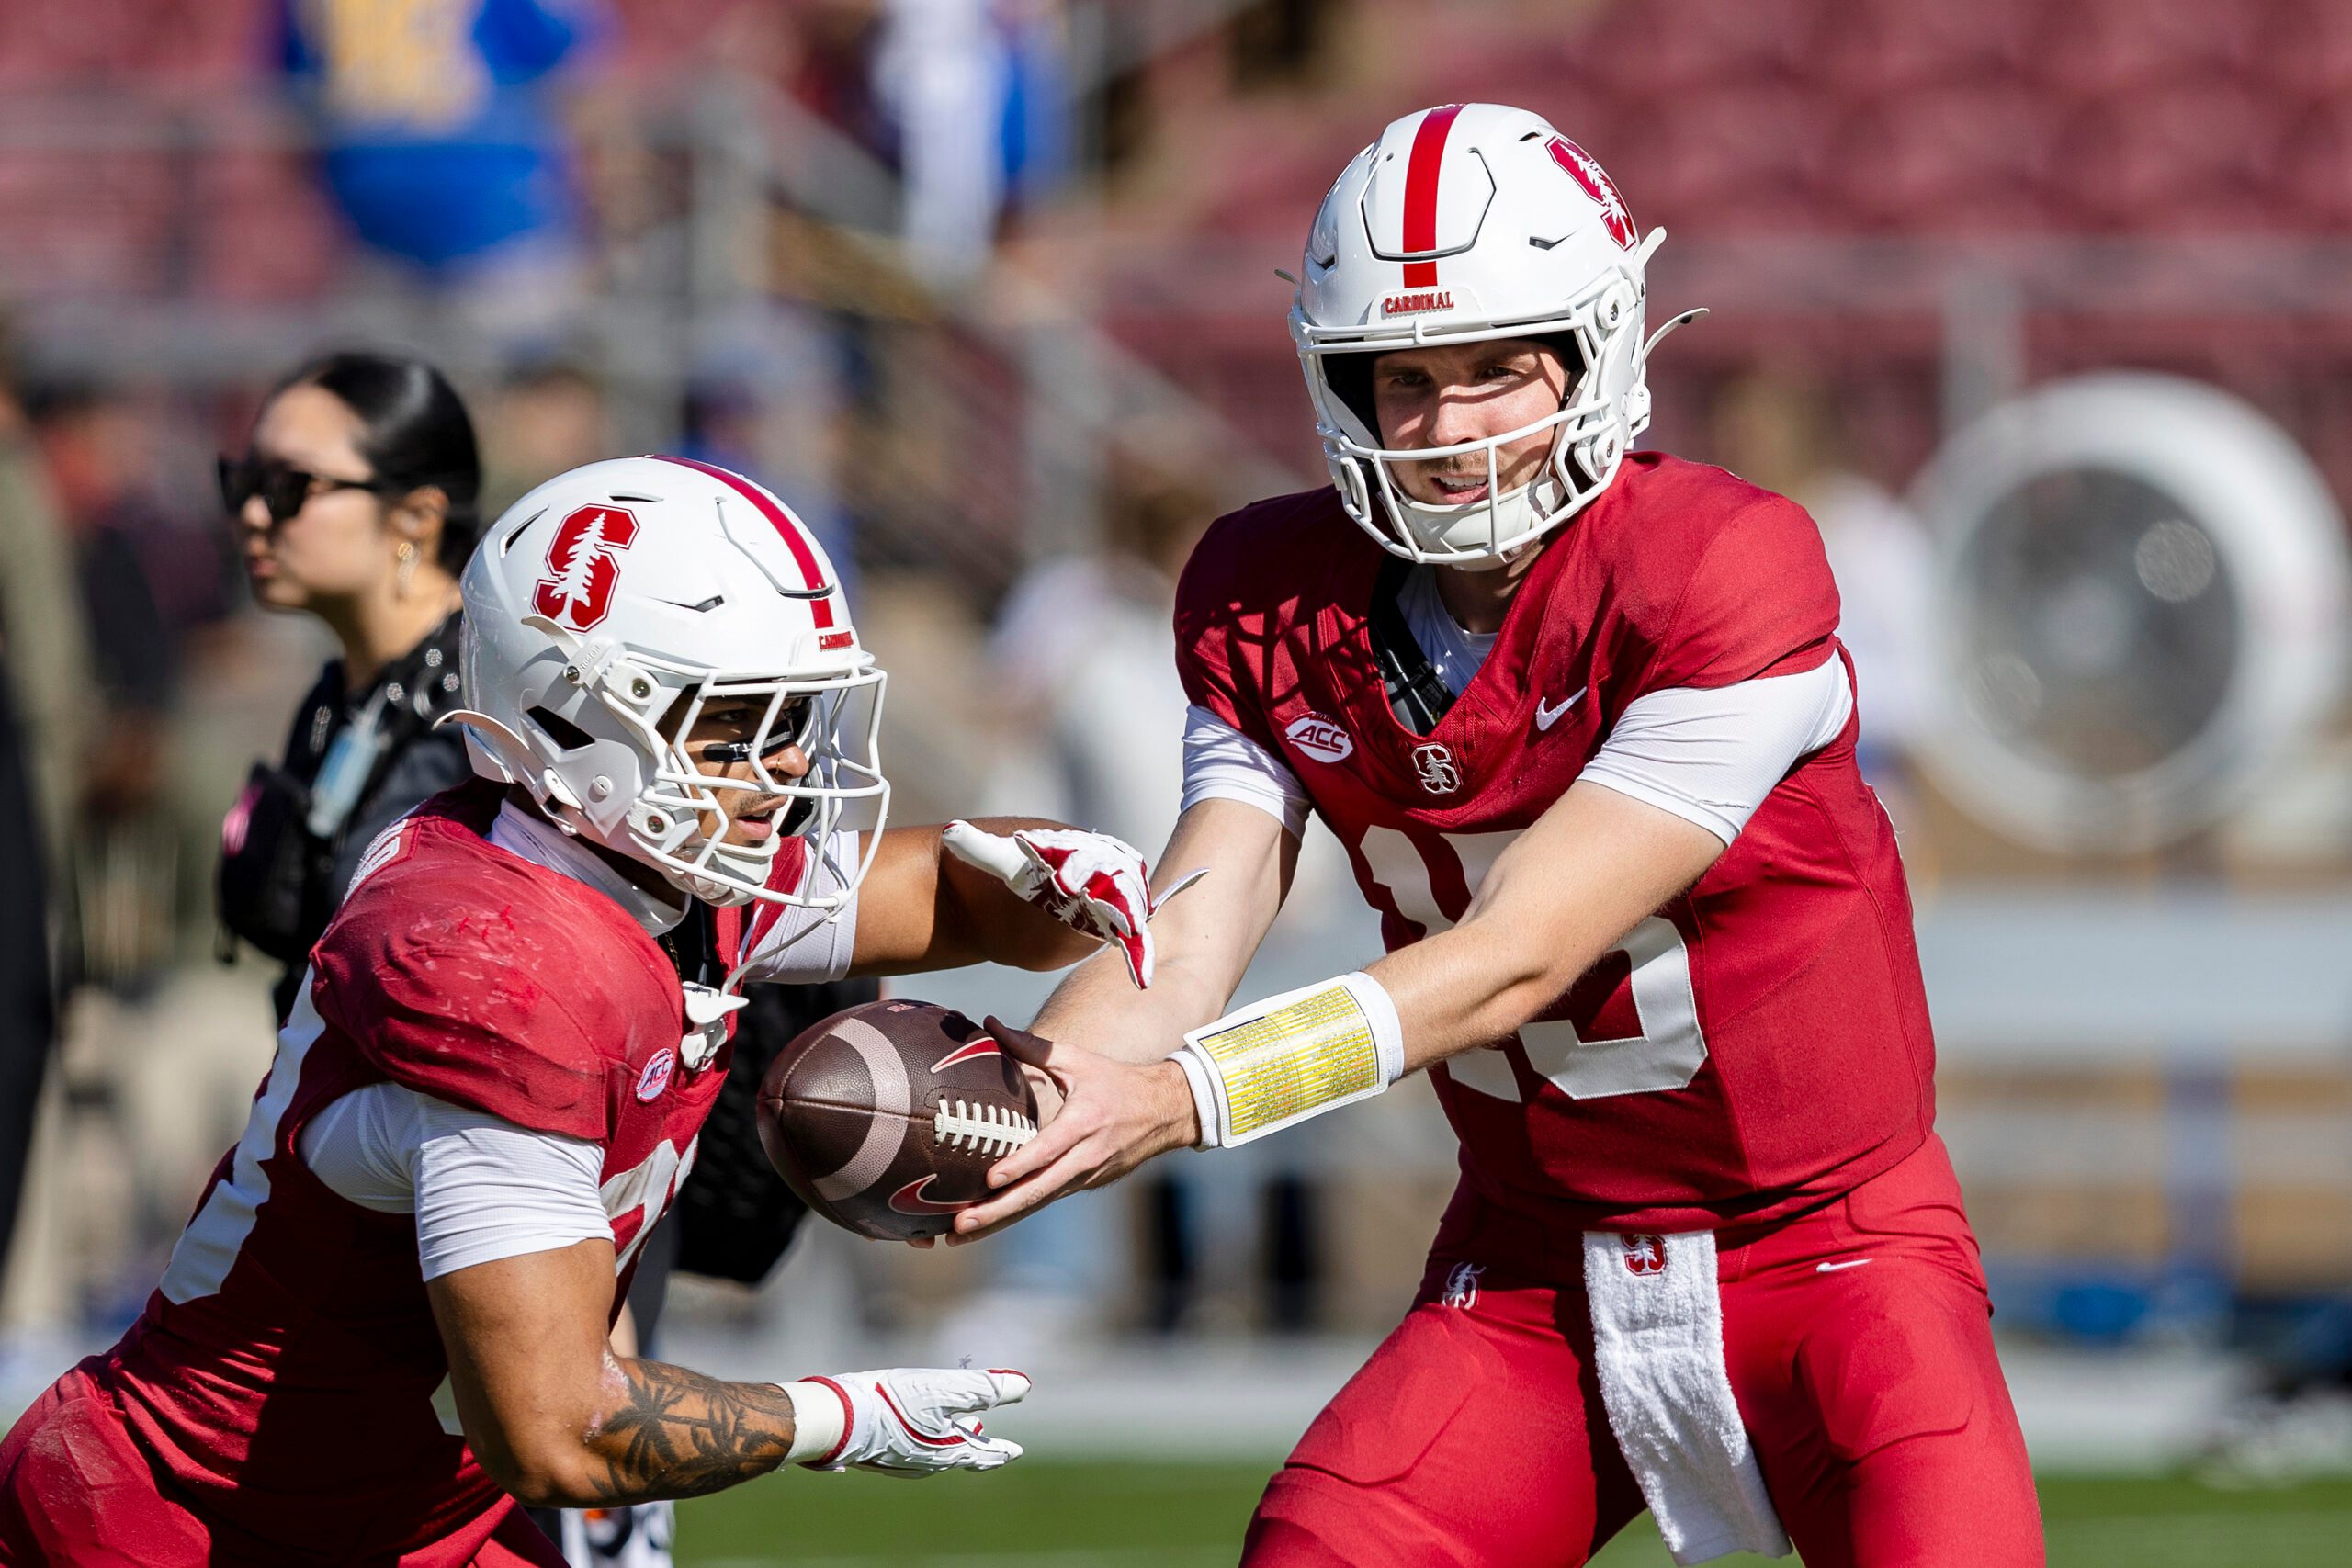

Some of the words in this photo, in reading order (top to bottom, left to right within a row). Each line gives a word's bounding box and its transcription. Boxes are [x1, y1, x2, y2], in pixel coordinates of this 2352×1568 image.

[1385, 291, 1454, 314] CARDINAL
[1294, 724, 1347, 750] ACC
[640, 1058, 669, 1090] ACC
